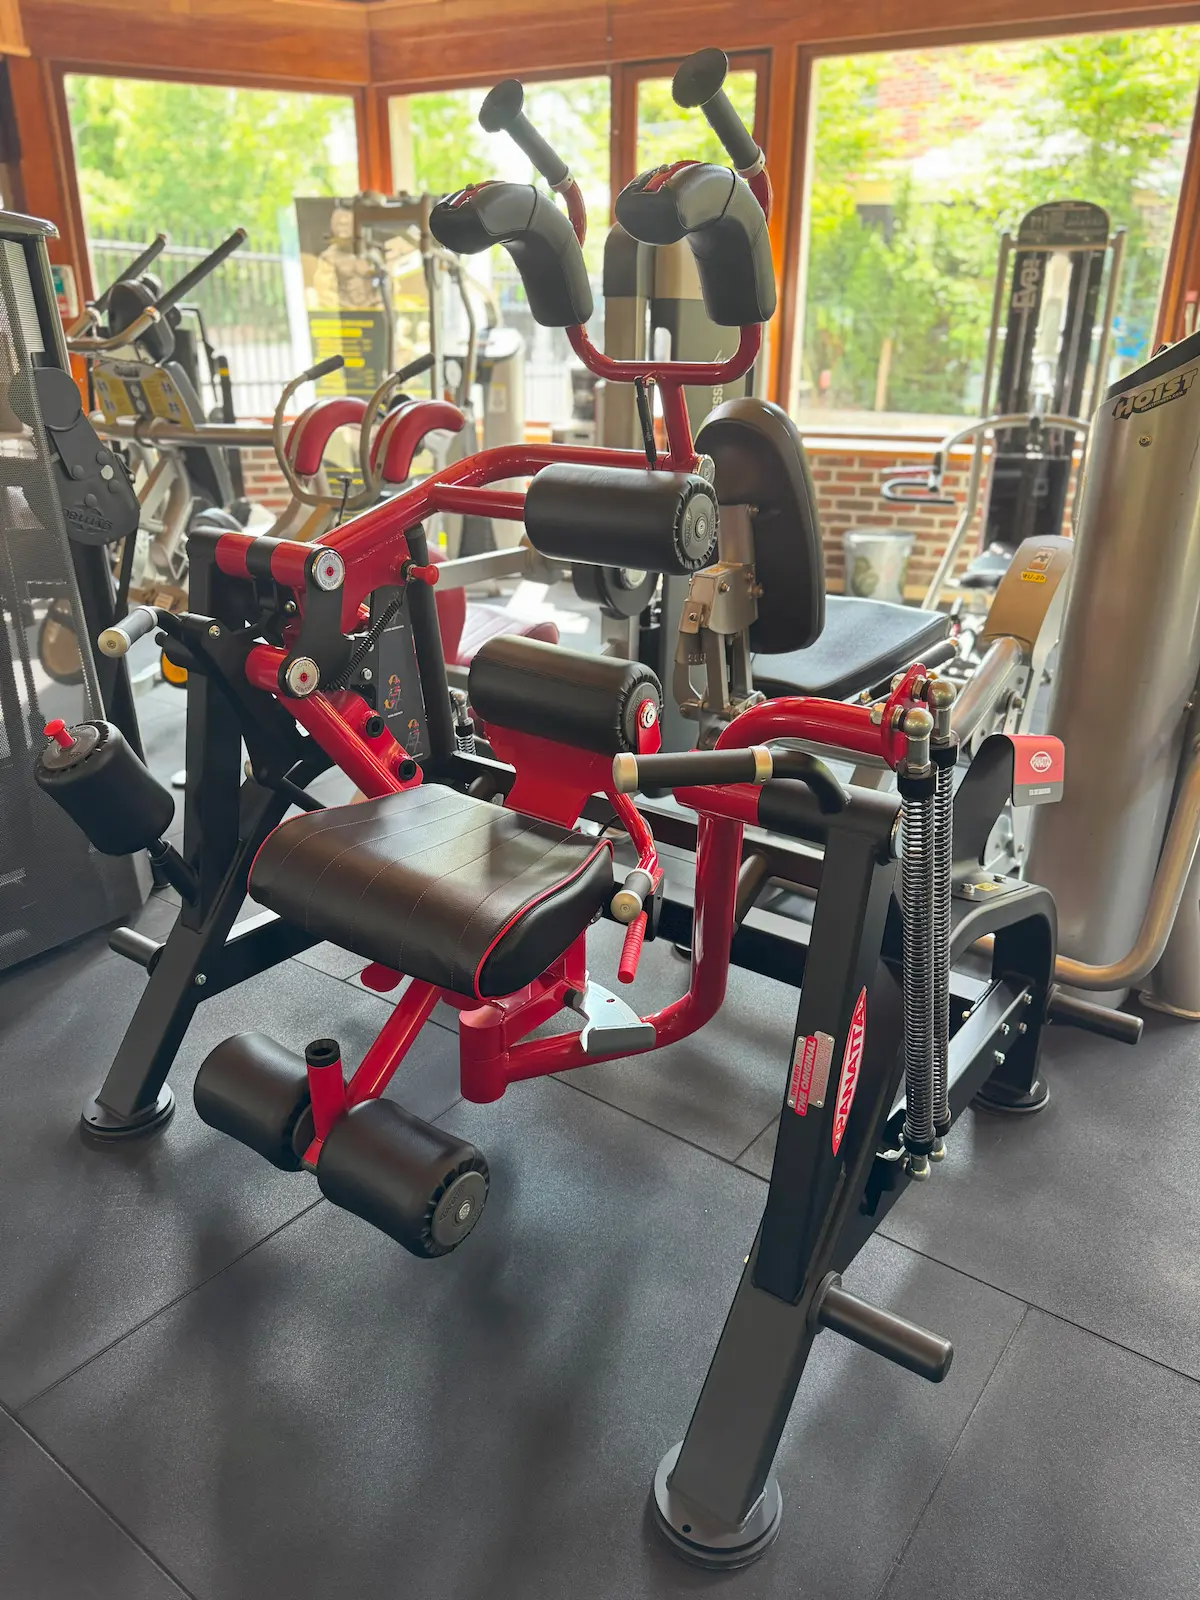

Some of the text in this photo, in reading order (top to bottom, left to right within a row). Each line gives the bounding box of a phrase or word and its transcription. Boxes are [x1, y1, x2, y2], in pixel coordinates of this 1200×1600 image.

[1112, 368, 1198, 420] HOIST
[797, 1040, 816, 1113] THE ORIGINAL
[837, 1003, 865, 1131] PANATTA
